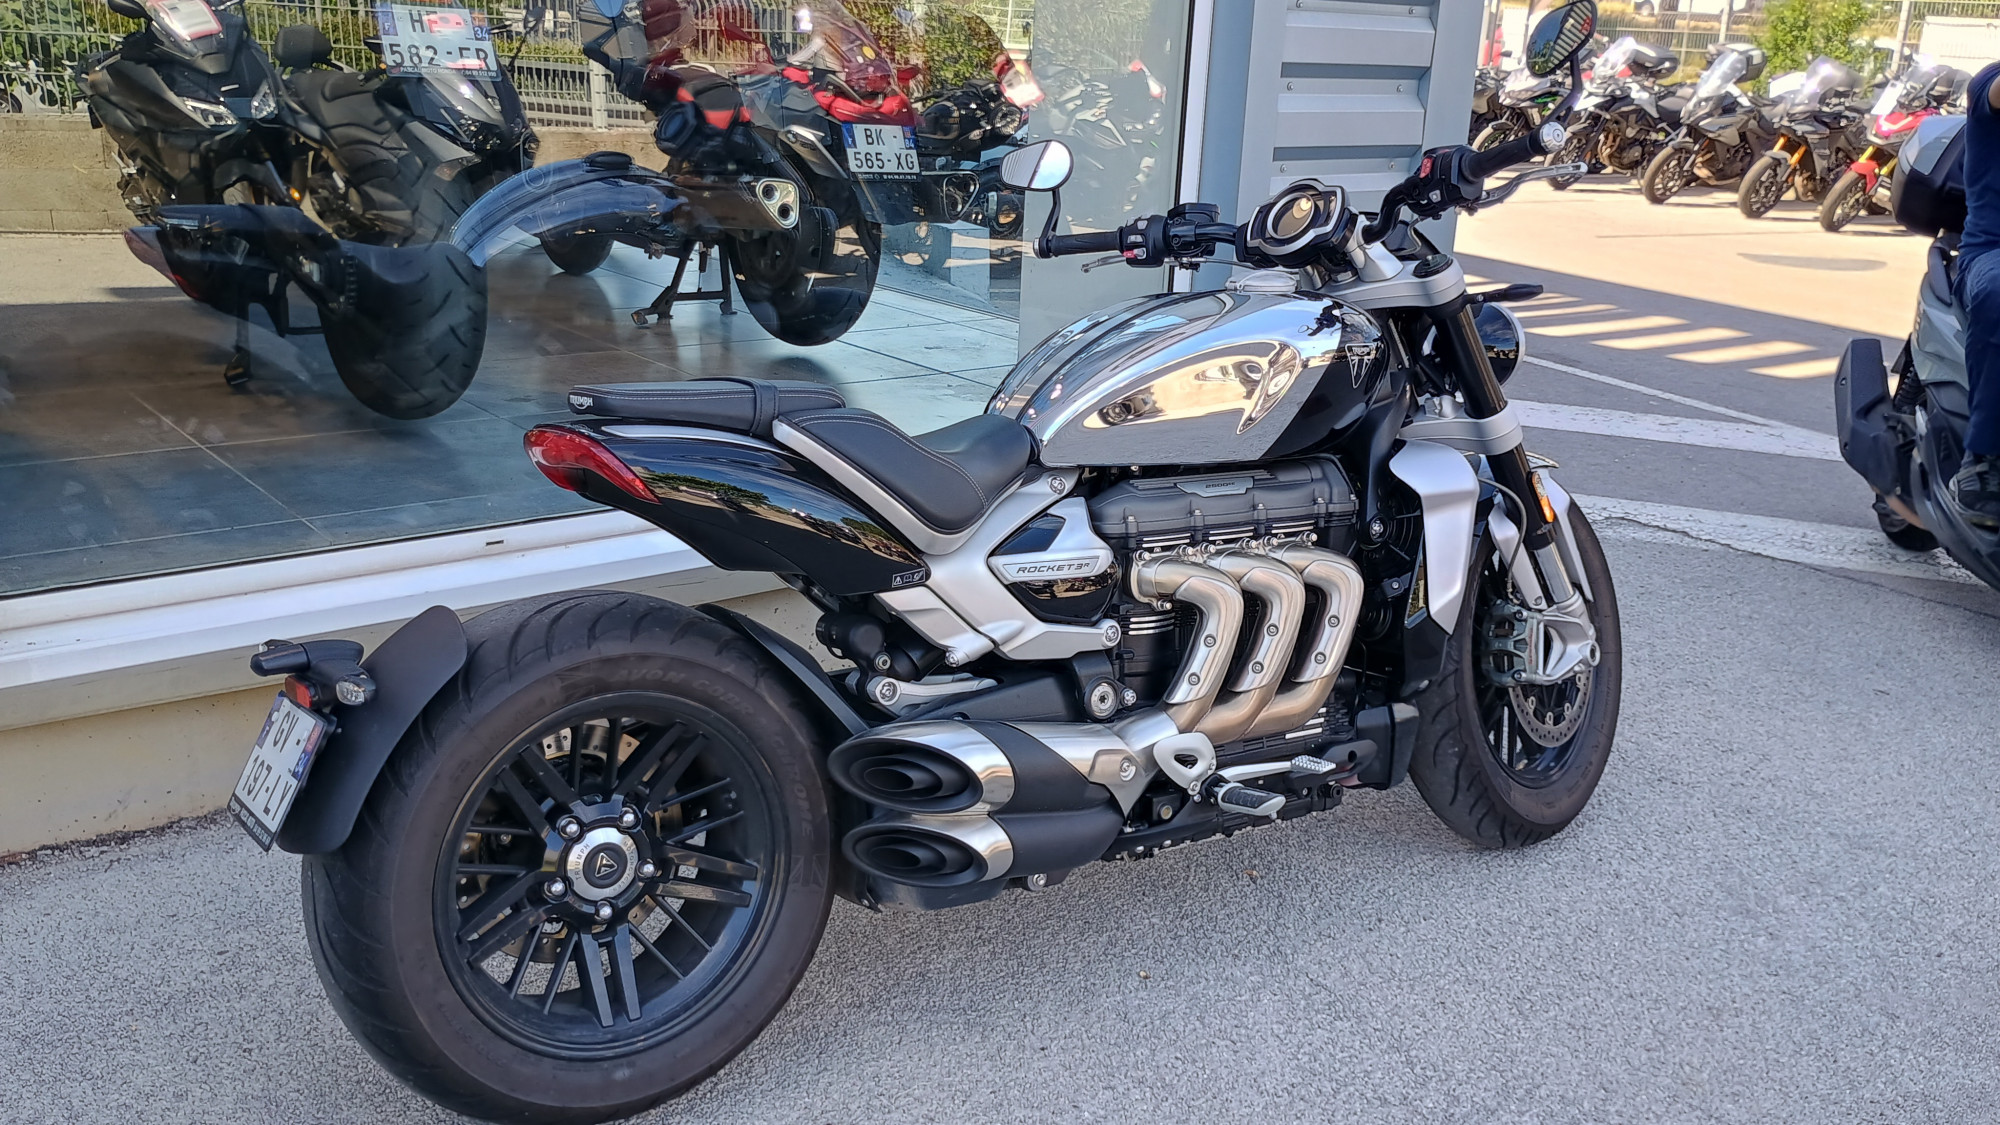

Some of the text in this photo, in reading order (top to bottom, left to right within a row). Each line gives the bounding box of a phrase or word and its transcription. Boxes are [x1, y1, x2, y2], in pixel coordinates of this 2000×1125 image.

[474, 27, 488, 38] 34
[864, 128, 885, 146] BK
[853, 151, 915, 171] 565-XG
[608, 668, 687, 683] AVON
[273, 710, 299, 753] GV
[242, 754, 292, 821] 197-LY
[573, 843, 591, 881] TRIUMPH
